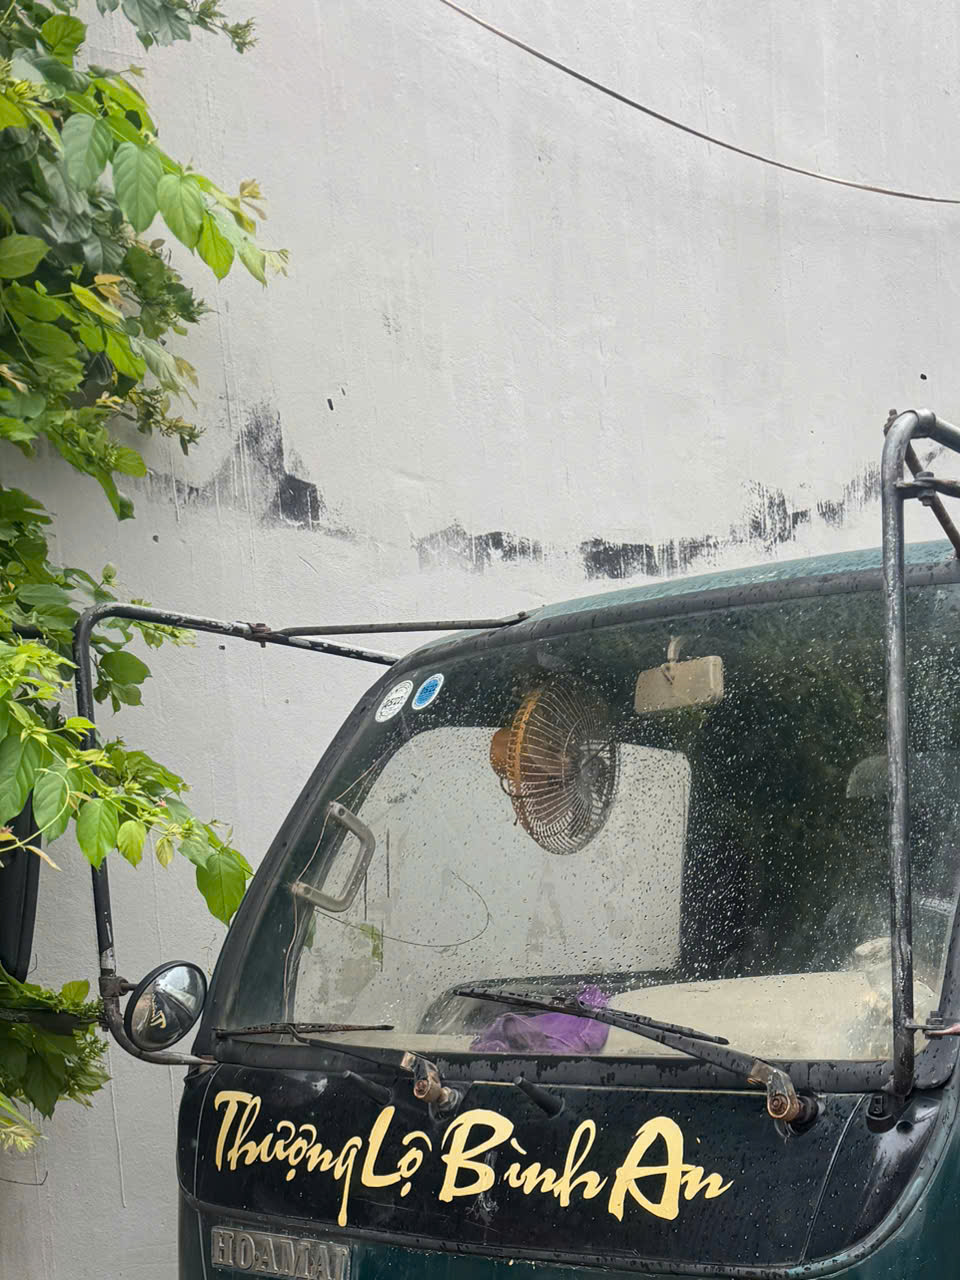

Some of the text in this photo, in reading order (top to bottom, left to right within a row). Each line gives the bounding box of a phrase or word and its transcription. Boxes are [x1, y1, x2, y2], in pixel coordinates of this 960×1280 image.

[214, 1091, 733, 1226] Thượng Lộ Bình An
